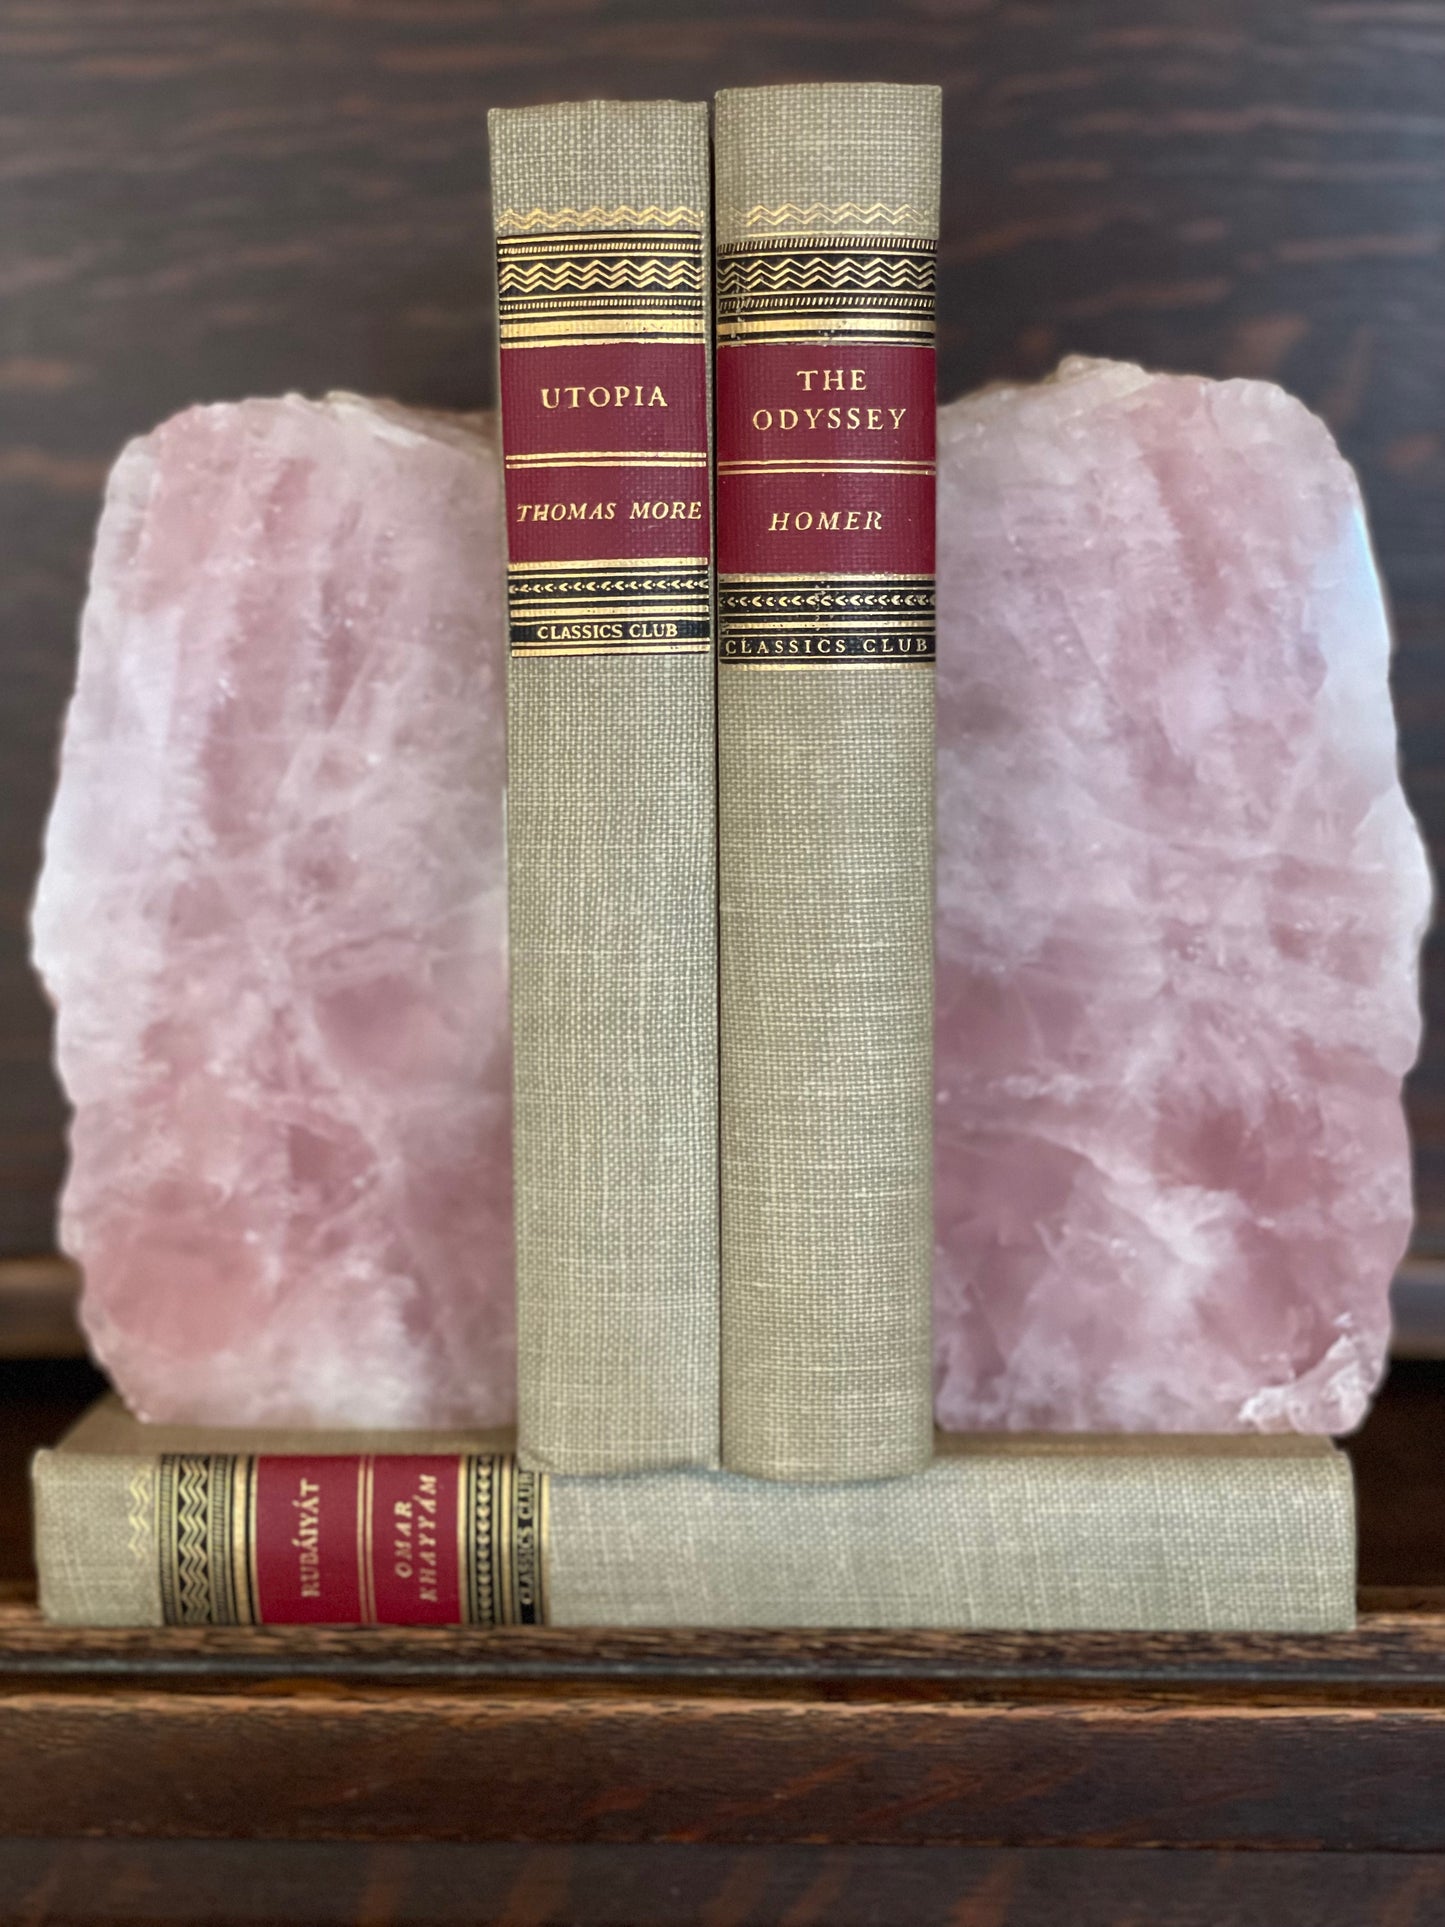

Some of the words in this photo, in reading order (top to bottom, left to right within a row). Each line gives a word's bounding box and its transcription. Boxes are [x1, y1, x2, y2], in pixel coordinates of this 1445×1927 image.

[796, 369, 867, 391] THE
[541, 385, 668, 409] UTOPIA
[752, 407, 907, 431] ODYSSEY
[516, 502, 616, 523] THOMAS
[629, 500, 702, 521] MORE
[768, 510, 883, 532] HOMER
[536, 623, 623, 640] CLASSICS
[628, 622, 678, 639] CLUB
[724, 638, 847, 655] CLASSICS
[863, 637, 928, 653] CLUB
[393, 1500, 413, 1579] OMAR
[413, 1473, 438, 1603] KHAYYÁM
[518, 1527, 534, 1606] CLASSICS
